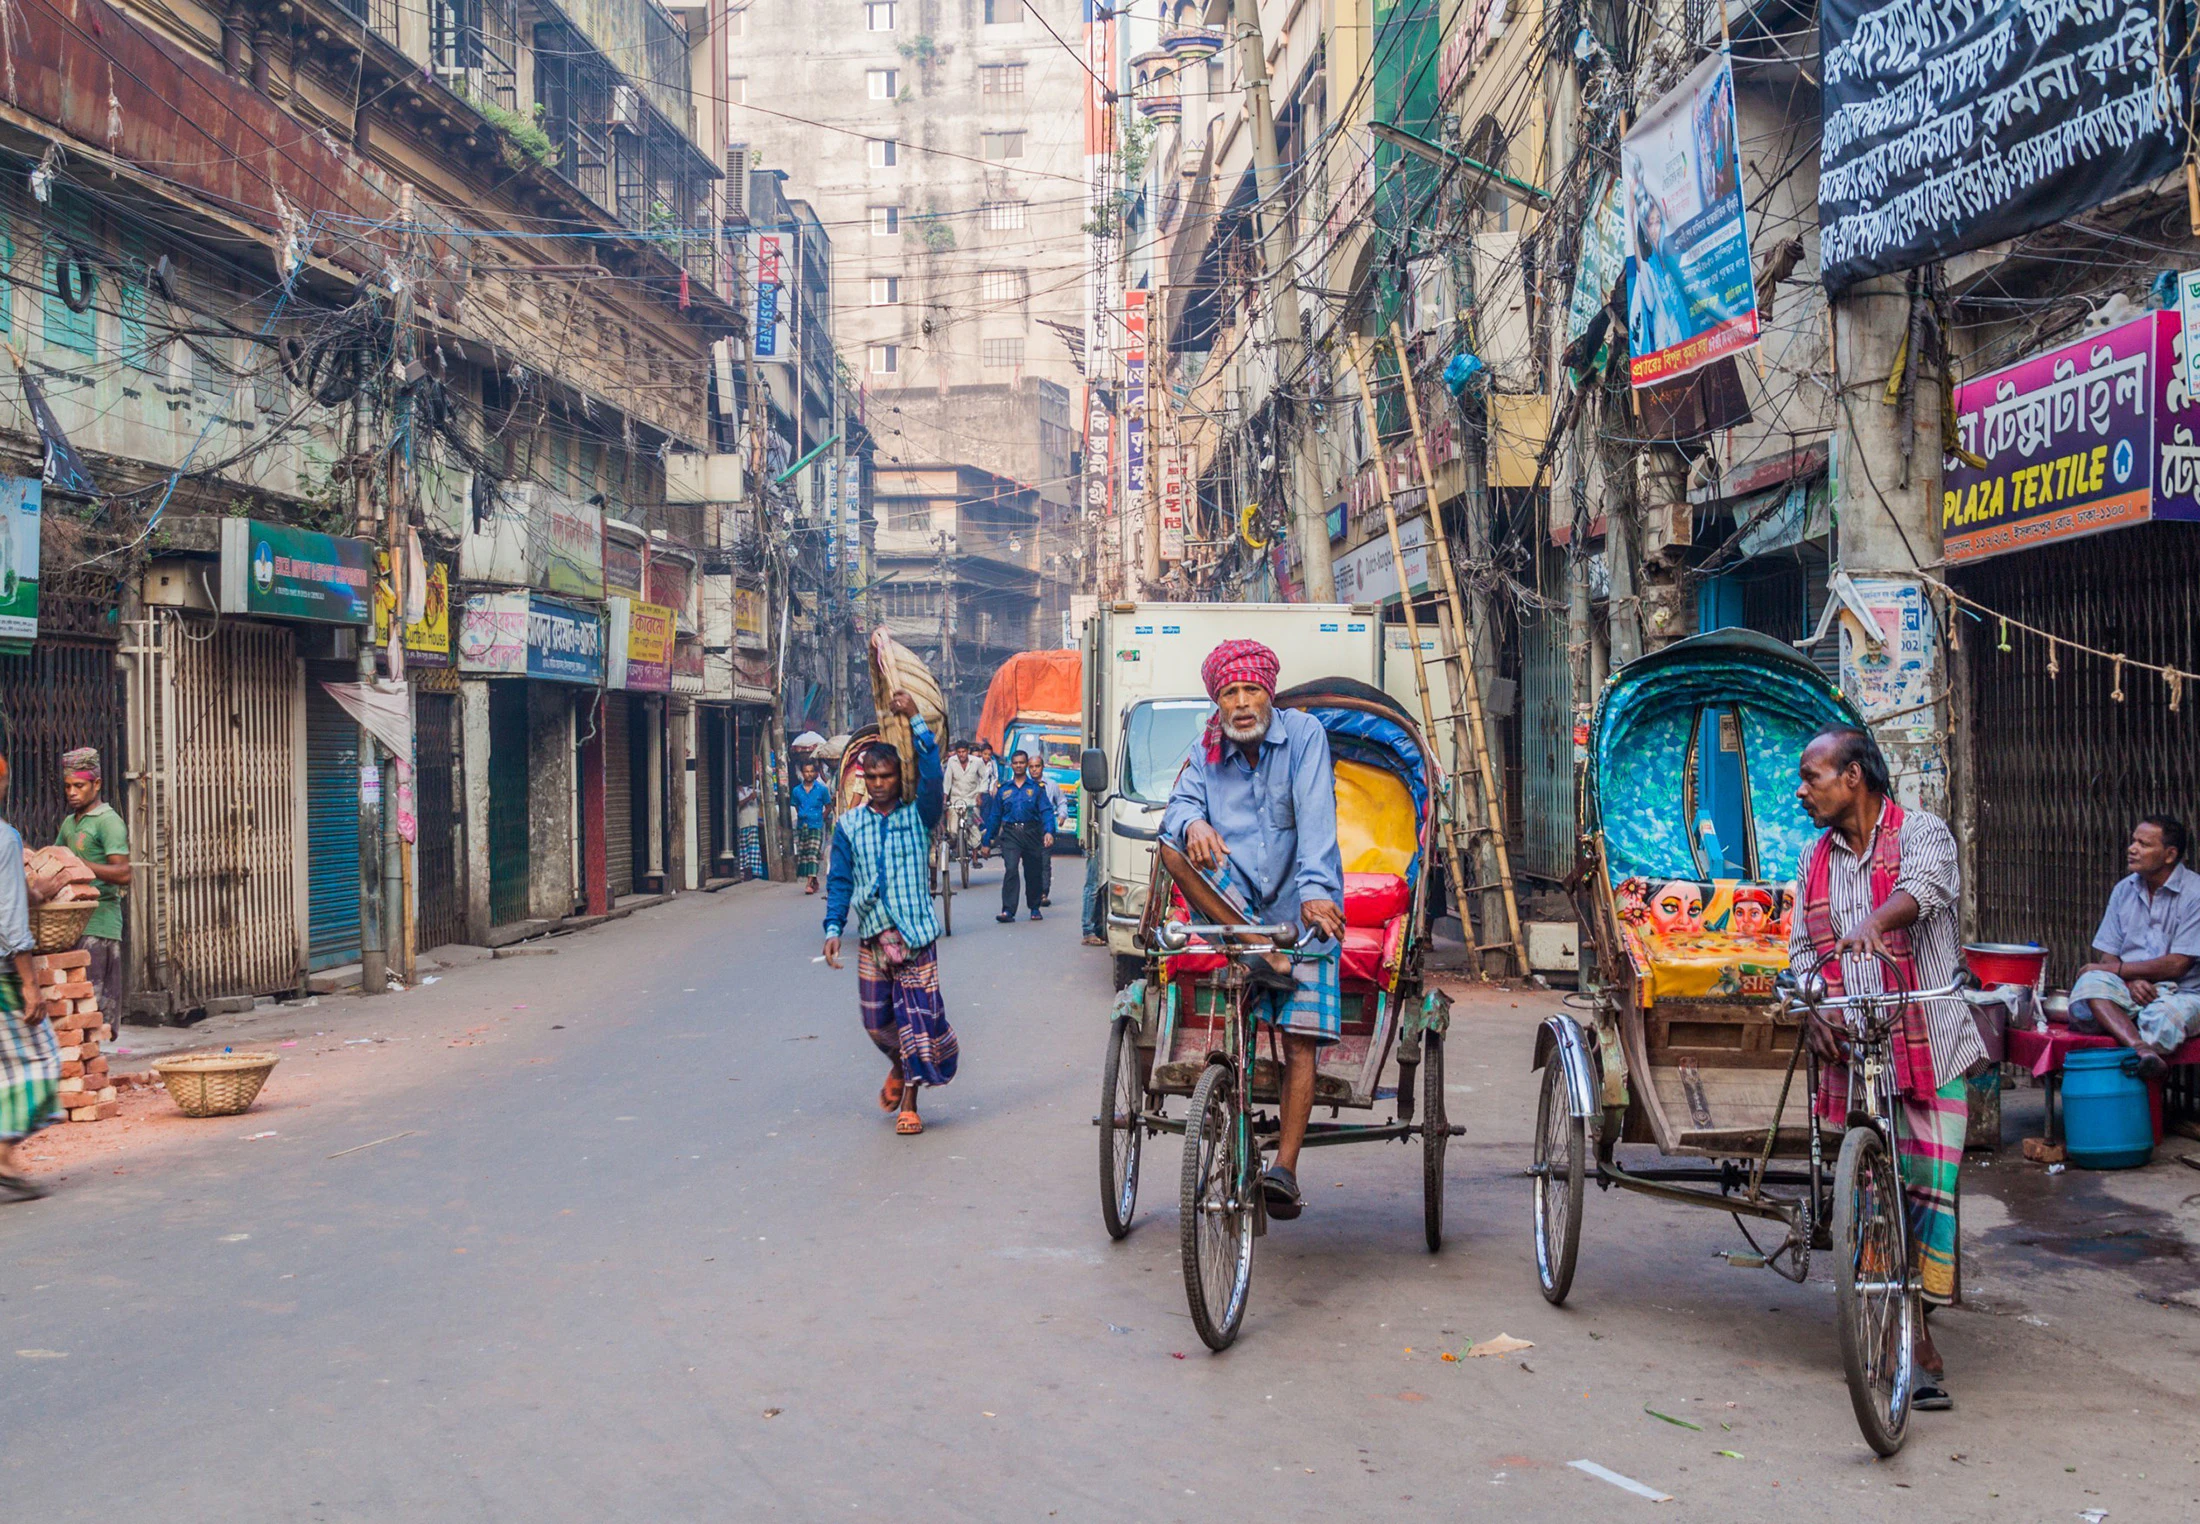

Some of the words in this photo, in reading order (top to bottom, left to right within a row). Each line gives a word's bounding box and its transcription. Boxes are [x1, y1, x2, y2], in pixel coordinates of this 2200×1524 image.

[1978, 53, 2078, 134] কামনা
[1984, 344, 2147, 460] টেক্সটাইল
[1943, 476, 2004, 530] PLAZA
[2012, 444, 2108, 512] TEXTILE
[428, 632, 447, 647] House
